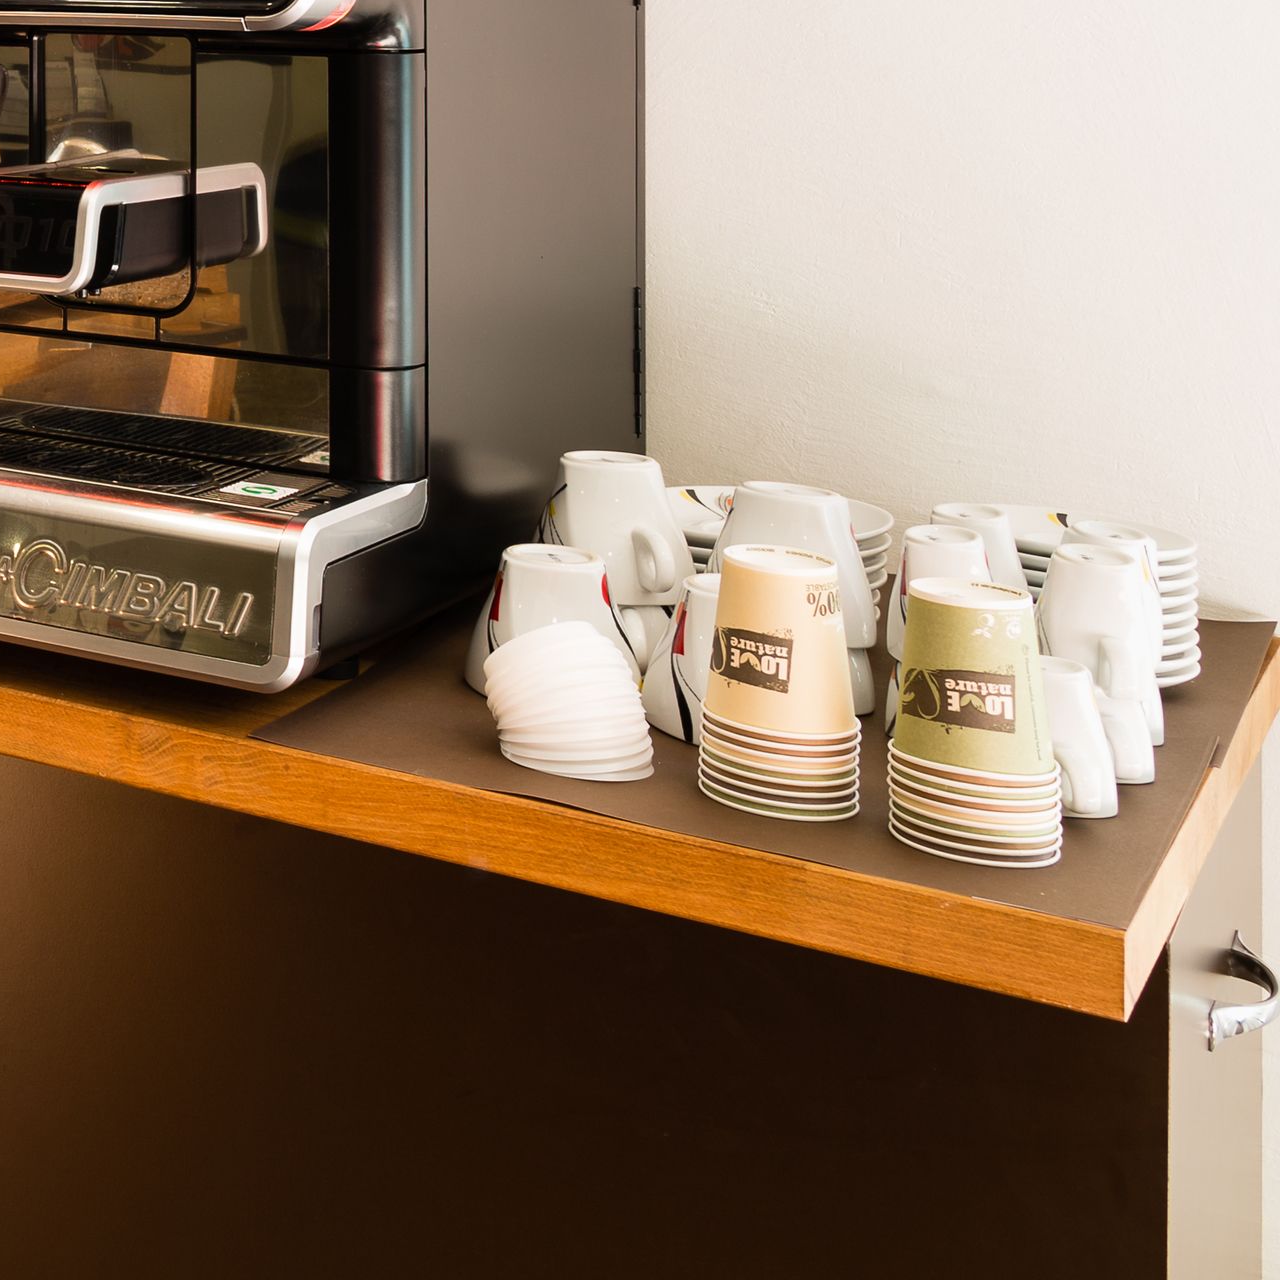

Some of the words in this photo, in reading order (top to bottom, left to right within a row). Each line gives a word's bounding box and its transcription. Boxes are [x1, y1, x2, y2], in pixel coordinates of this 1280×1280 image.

[12, 538, 255, 637] CIMBALI
[730, 636, 789, 657] nature
[730, 647, 788, 681] LOVE
[945, 678, 1012, 696] nature
[947, 691, 1014, 720] LOVE
